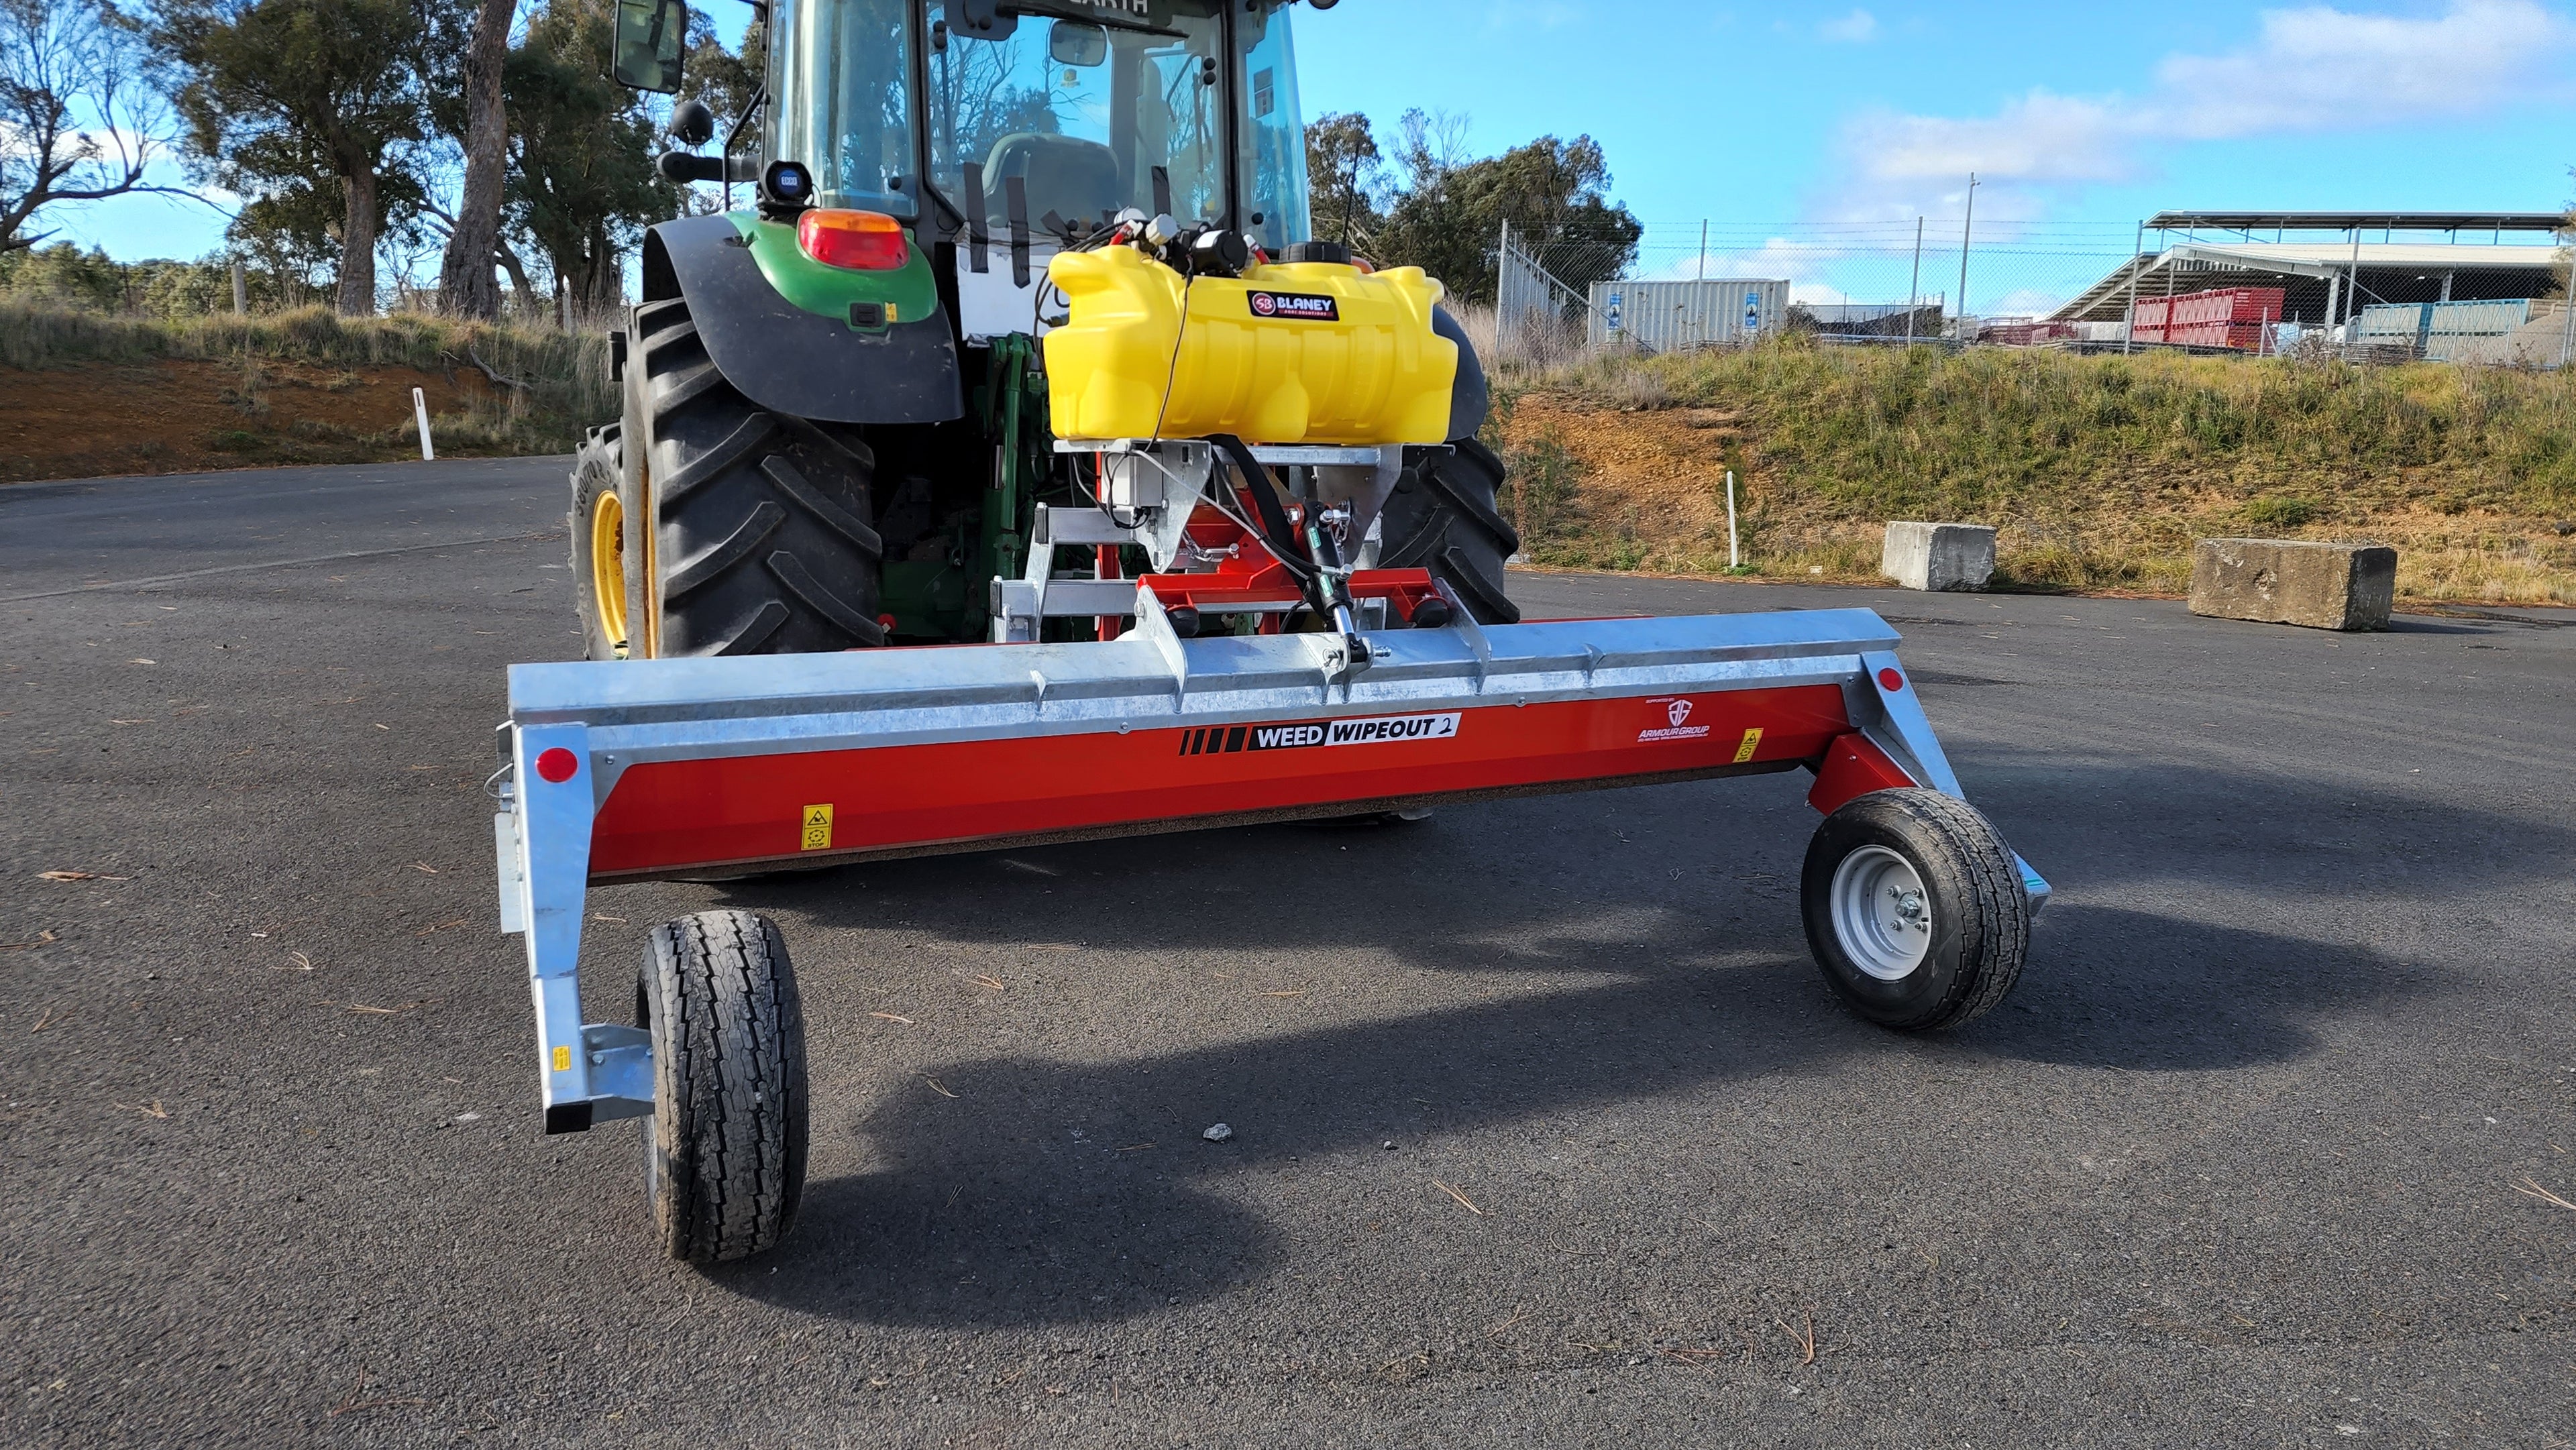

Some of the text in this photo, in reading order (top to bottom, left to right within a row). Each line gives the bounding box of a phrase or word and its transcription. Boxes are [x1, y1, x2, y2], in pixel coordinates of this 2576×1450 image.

[781, 176, 798, 186] ECCO
[1277, 296, 1332, 311] BLANEY
[1256, 717, 1452, 748] WEED WIPEOUT 2
[1638, 725, 1710, 738] ARMOUR GROUP
